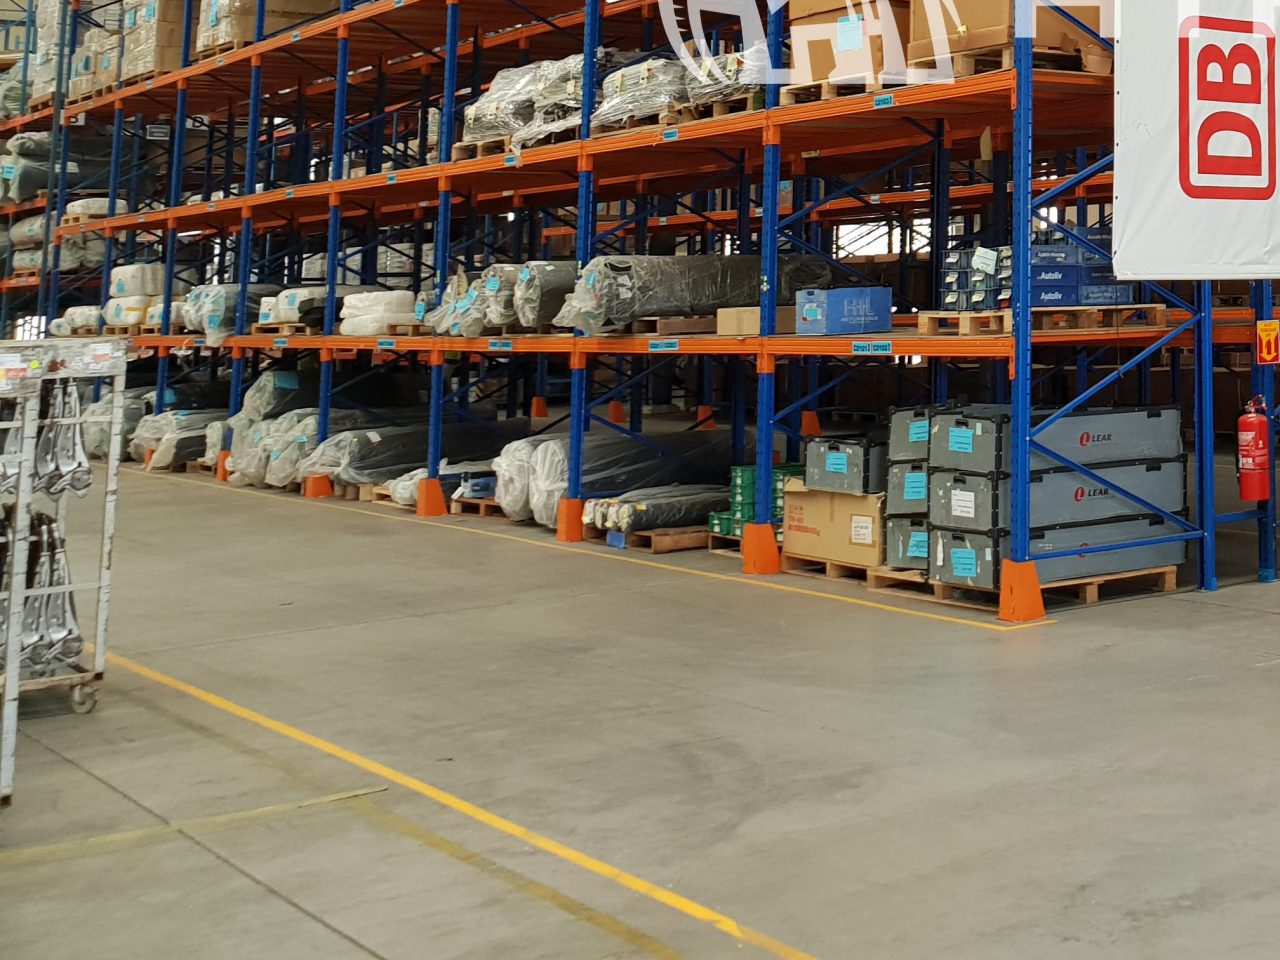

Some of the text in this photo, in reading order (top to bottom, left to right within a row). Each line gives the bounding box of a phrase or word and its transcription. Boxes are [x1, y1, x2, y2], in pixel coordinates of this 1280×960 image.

[1196, 42, 1263, 177] DB
[1040, 271, 1063, 280] Autoliv
[1040, 291, 1063, 301] Autoliv
[1092, 433, 1113, 443] LEAR
[1088, 488, 1110, 497] LEAR
